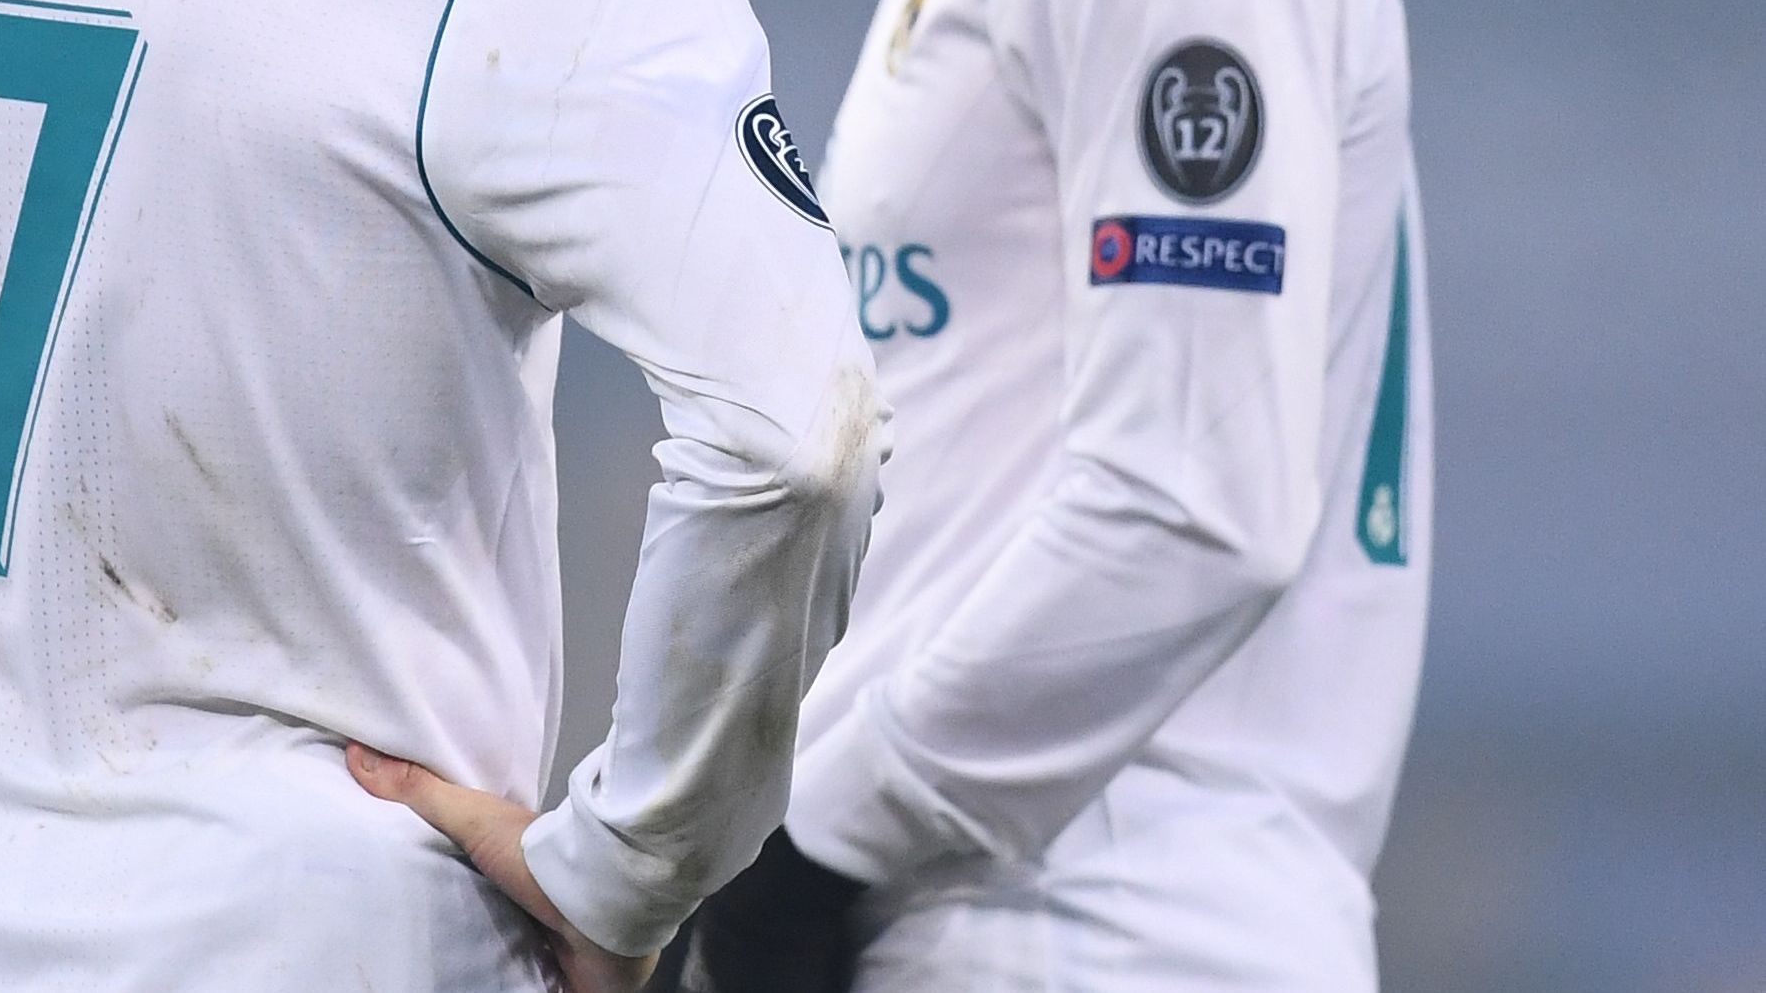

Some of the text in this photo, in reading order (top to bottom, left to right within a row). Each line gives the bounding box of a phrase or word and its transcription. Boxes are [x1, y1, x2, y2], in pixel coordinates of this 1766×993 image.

[1176, 117, 1223, 159] 12
[1135, 233, 1285, 276] RESPECT
[839, 243, 951, 341] es
